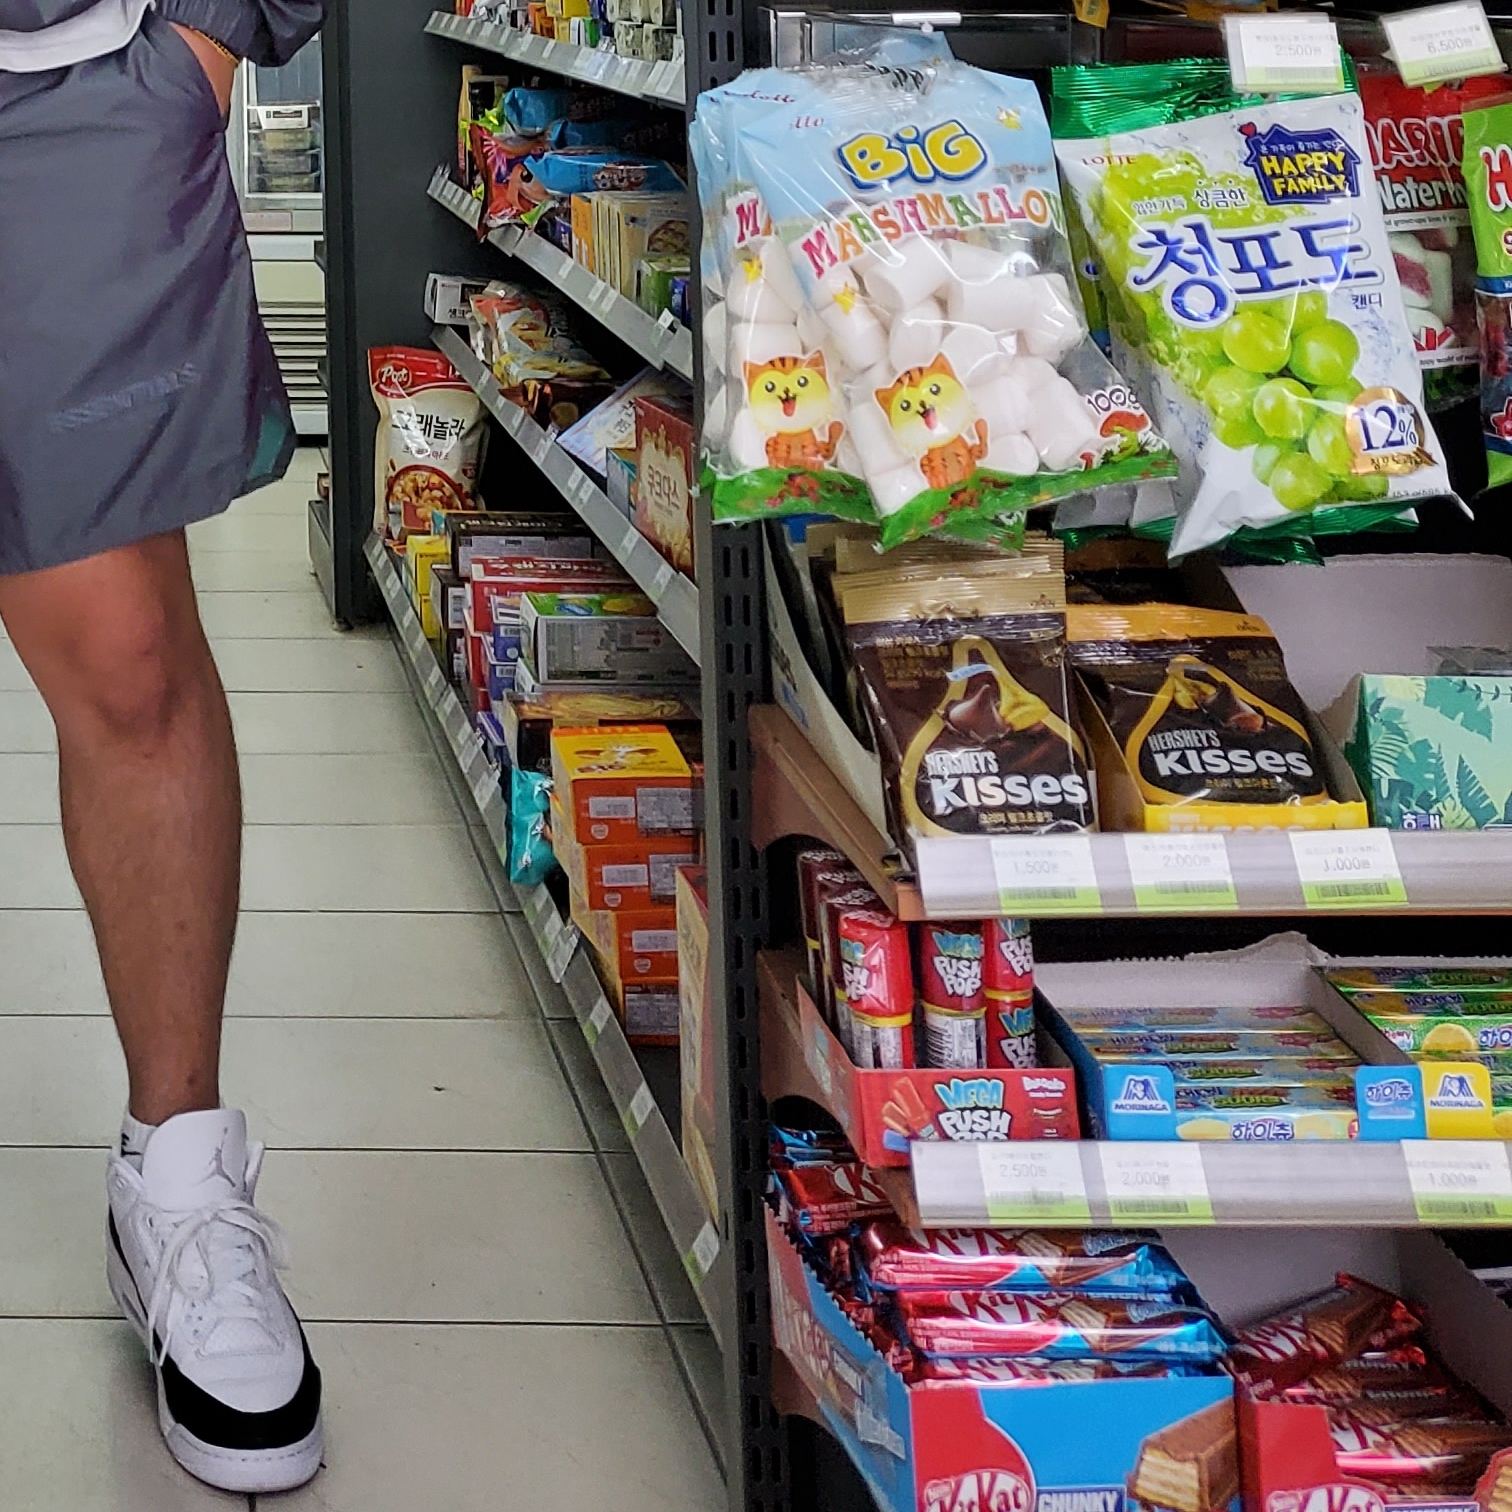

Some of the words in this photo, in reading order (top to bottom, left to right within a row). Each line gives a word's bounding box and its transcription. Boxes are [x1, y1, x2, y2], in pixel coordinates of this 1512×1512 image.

[1262, 153, 1346, 177] HAPPY
[1134, 218, 1382, 324] 청포도
[1352, 292, 1383, 311] 캔디
[381, 365, 408, 382] Post
[1088, 386, 1141, 414] 100g
[1361, 408, 1418, 453] 12%
[1149, 729, 1220, 751] HERSHEY'S
[926, 749, 998, 777] HERSHEY'S
[935, 956, 982, 979] PUSH
[944, 975, 981, 997] POP
[1366, 1081, 1413, 1102] 하이츄
[1114, 1102, 1171, 1112] MORINAGA
[1430, 1099, 1483, 1109] MORINAGA
[939, 1110, 1012, 1138] PUSH
[1232, 1120, 1294, 1140] 하이츄
